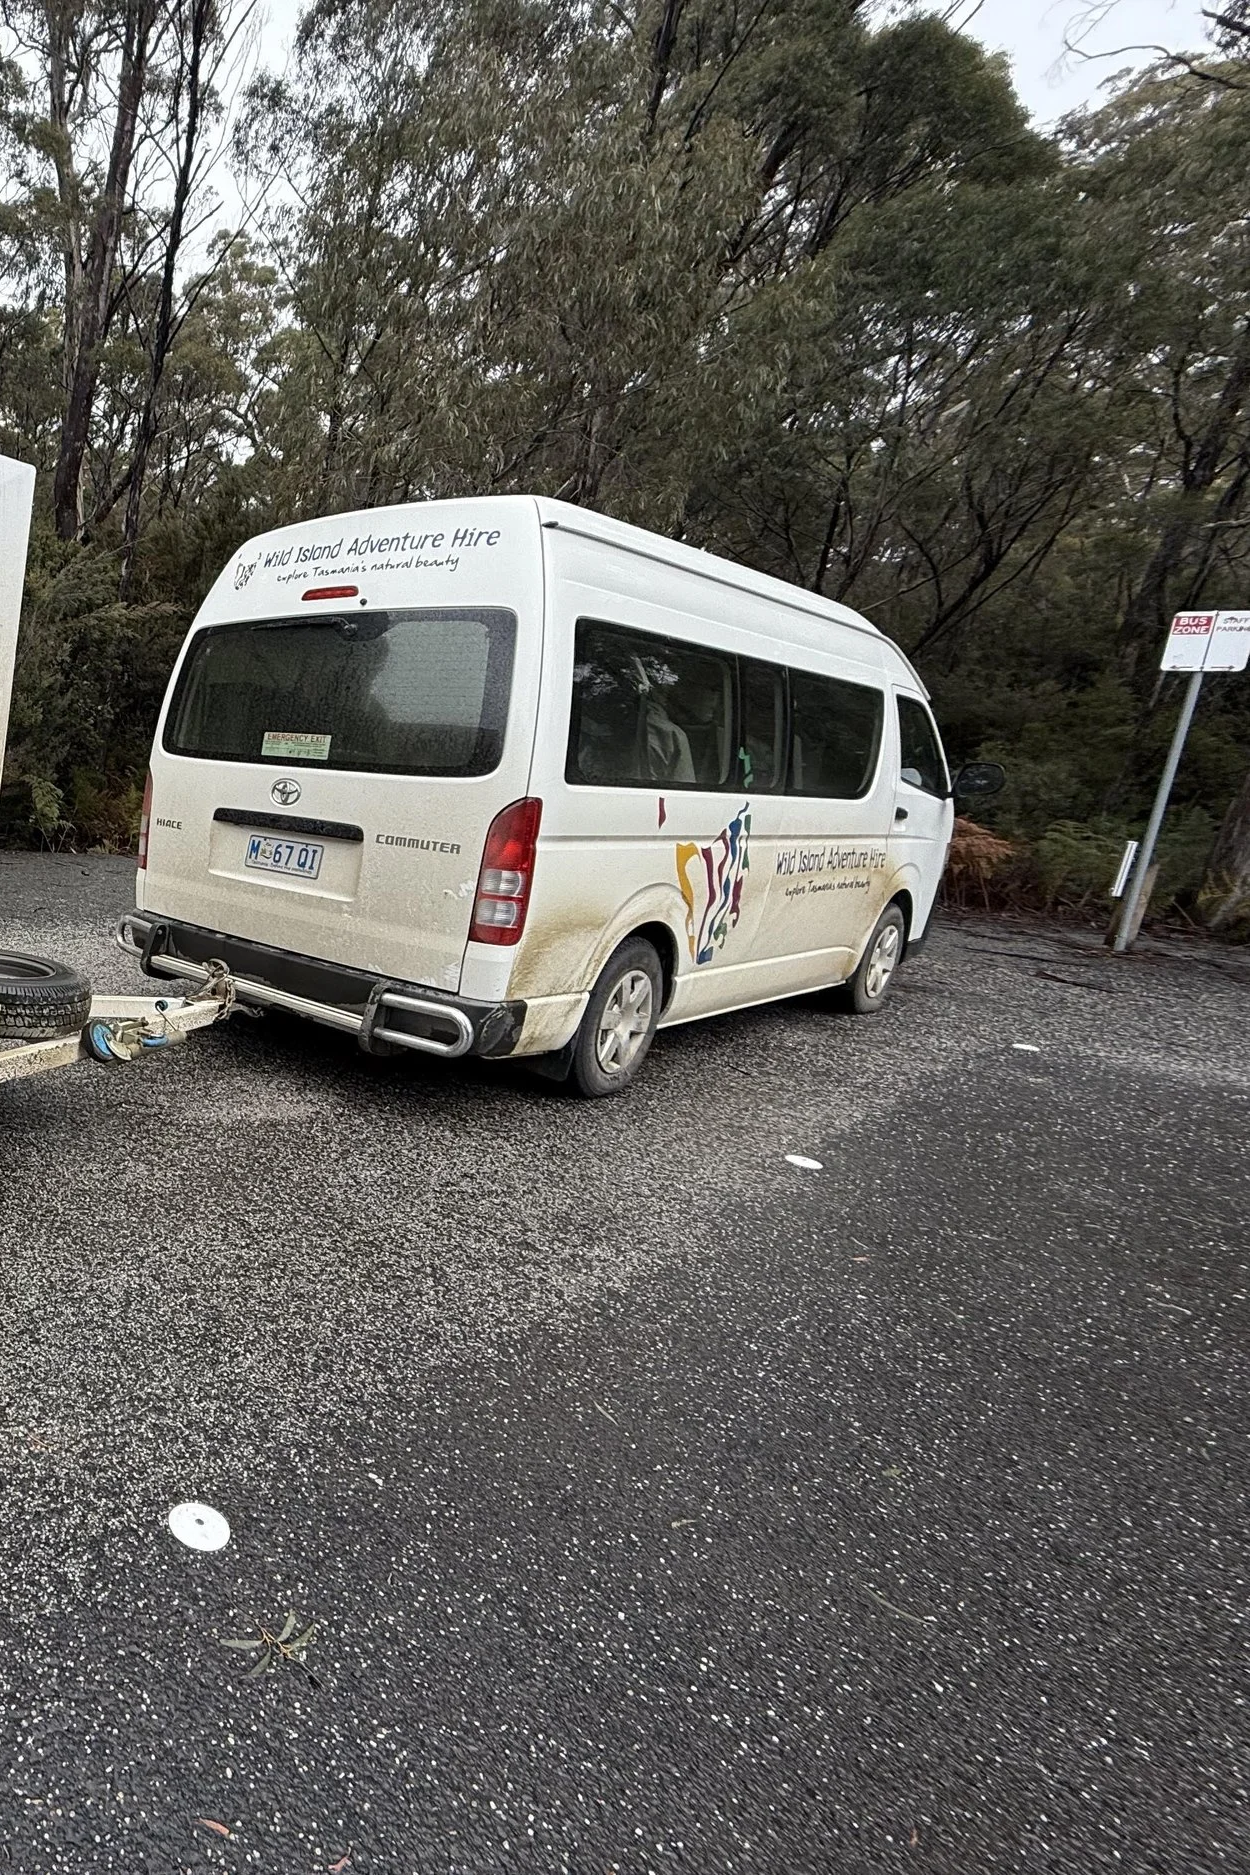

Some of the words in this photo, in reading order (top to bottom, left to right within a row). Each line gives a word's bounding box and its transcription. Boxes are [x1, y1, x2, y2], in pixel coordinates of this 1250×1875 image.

[264, 546, 293, 569] Wild
[295, 538, 343, 564] Island
[347, 533, 444, 556] Adventure
[451, 527, 501, 548] Hire
[277, 567, 309, 584] explore
[313, 561, 367, 578] Tasmania's
[370, 556, 413, 572] natural
[415, 554, 460, 572] beauty
[1178, 616, 1208, 625] BUS
[1173, 625, 1210, 634] ZONE
[267, 732, 309, 743] EMERGENCY
[310, 735, 327, 743] EXIT
[156, 817, 183, 830] HIACE
[375, 834, 461, 855] COMMUTER
[776, 848, 796, 876] Wild
[797, 846, 826, 873] Island
[827, 845, 869, 871] Adventure
[869, 848, 886, 869] Hire
